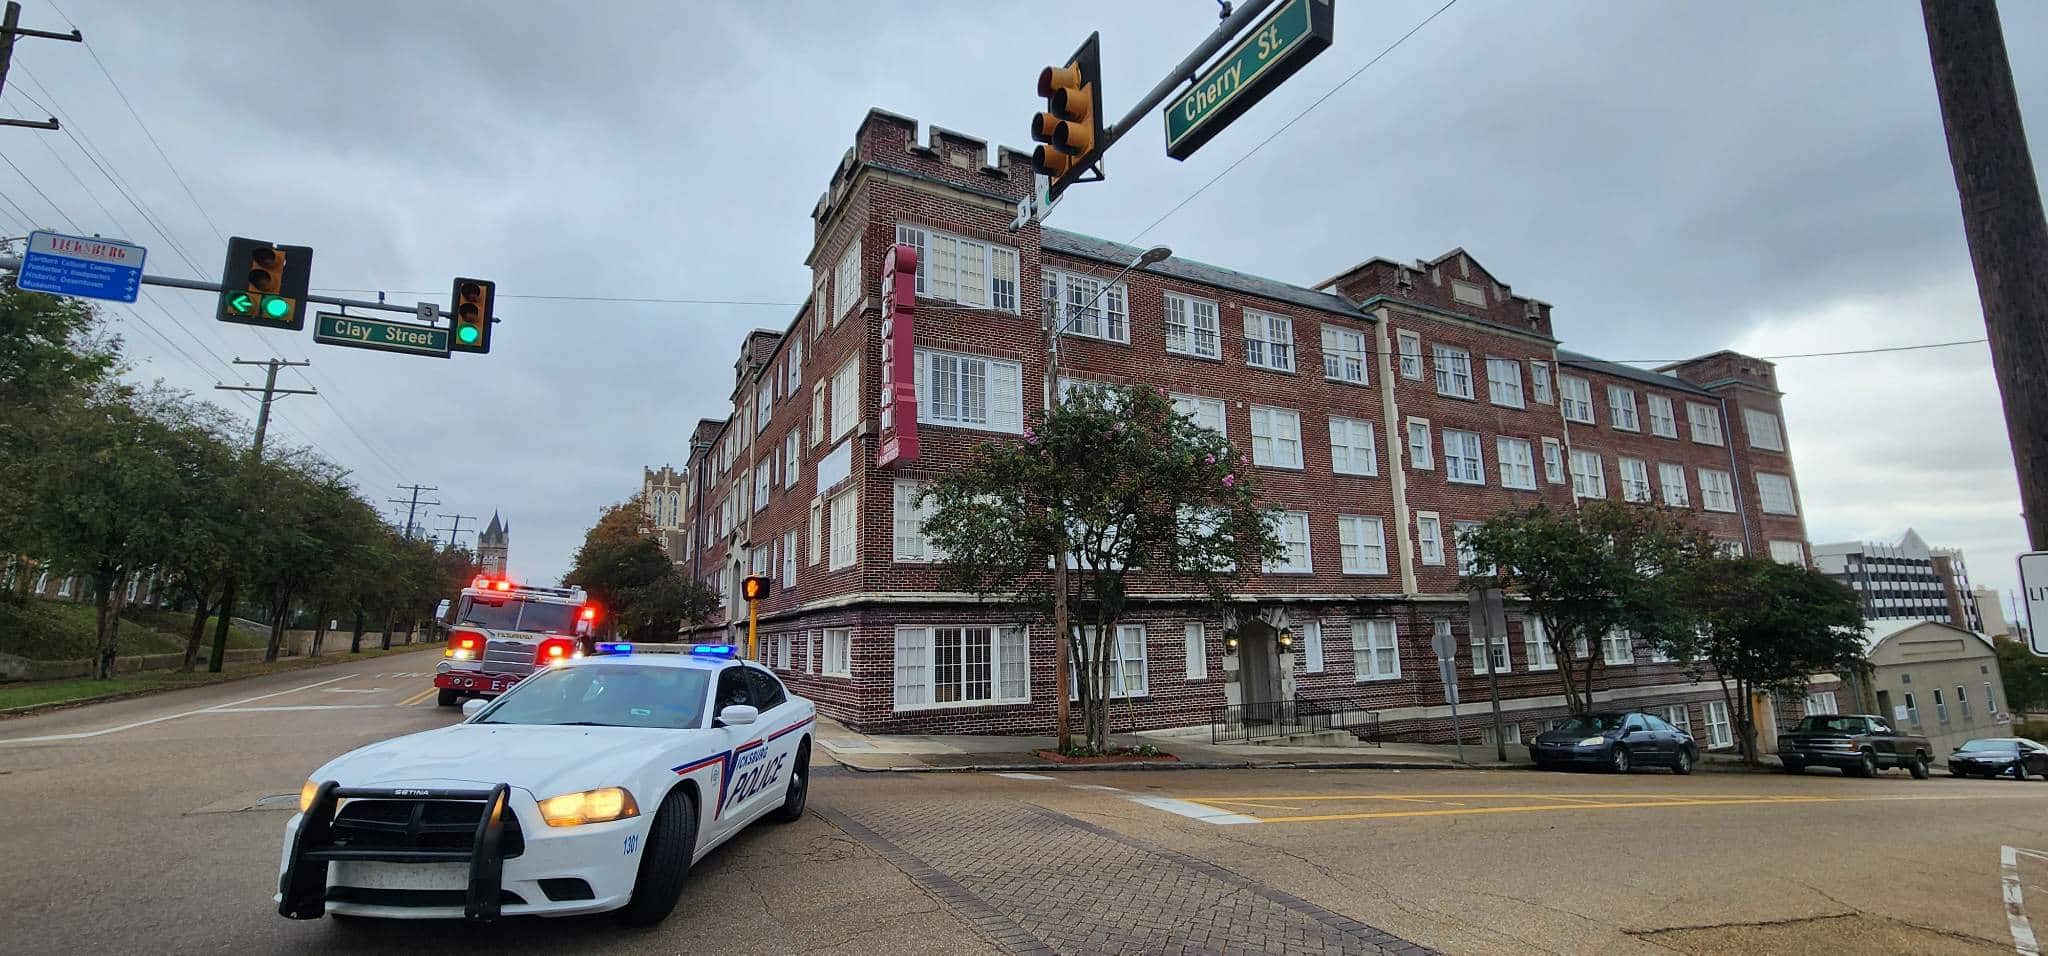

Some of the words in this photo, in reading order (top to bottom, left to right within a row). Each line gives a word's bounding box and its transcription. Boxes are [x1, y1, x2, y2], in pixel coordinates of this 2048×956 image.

[1185, 58, 1242, 122] Cherry
[1257, 23, 1283, 61] St.
[424, 307, 432, 317] 3
[334, 320, 372, 340] Clay
[385, 326, 433, 345] Street
[725, 752, 787, 810] POLICE
[623, 834, 638, 855] 1301
